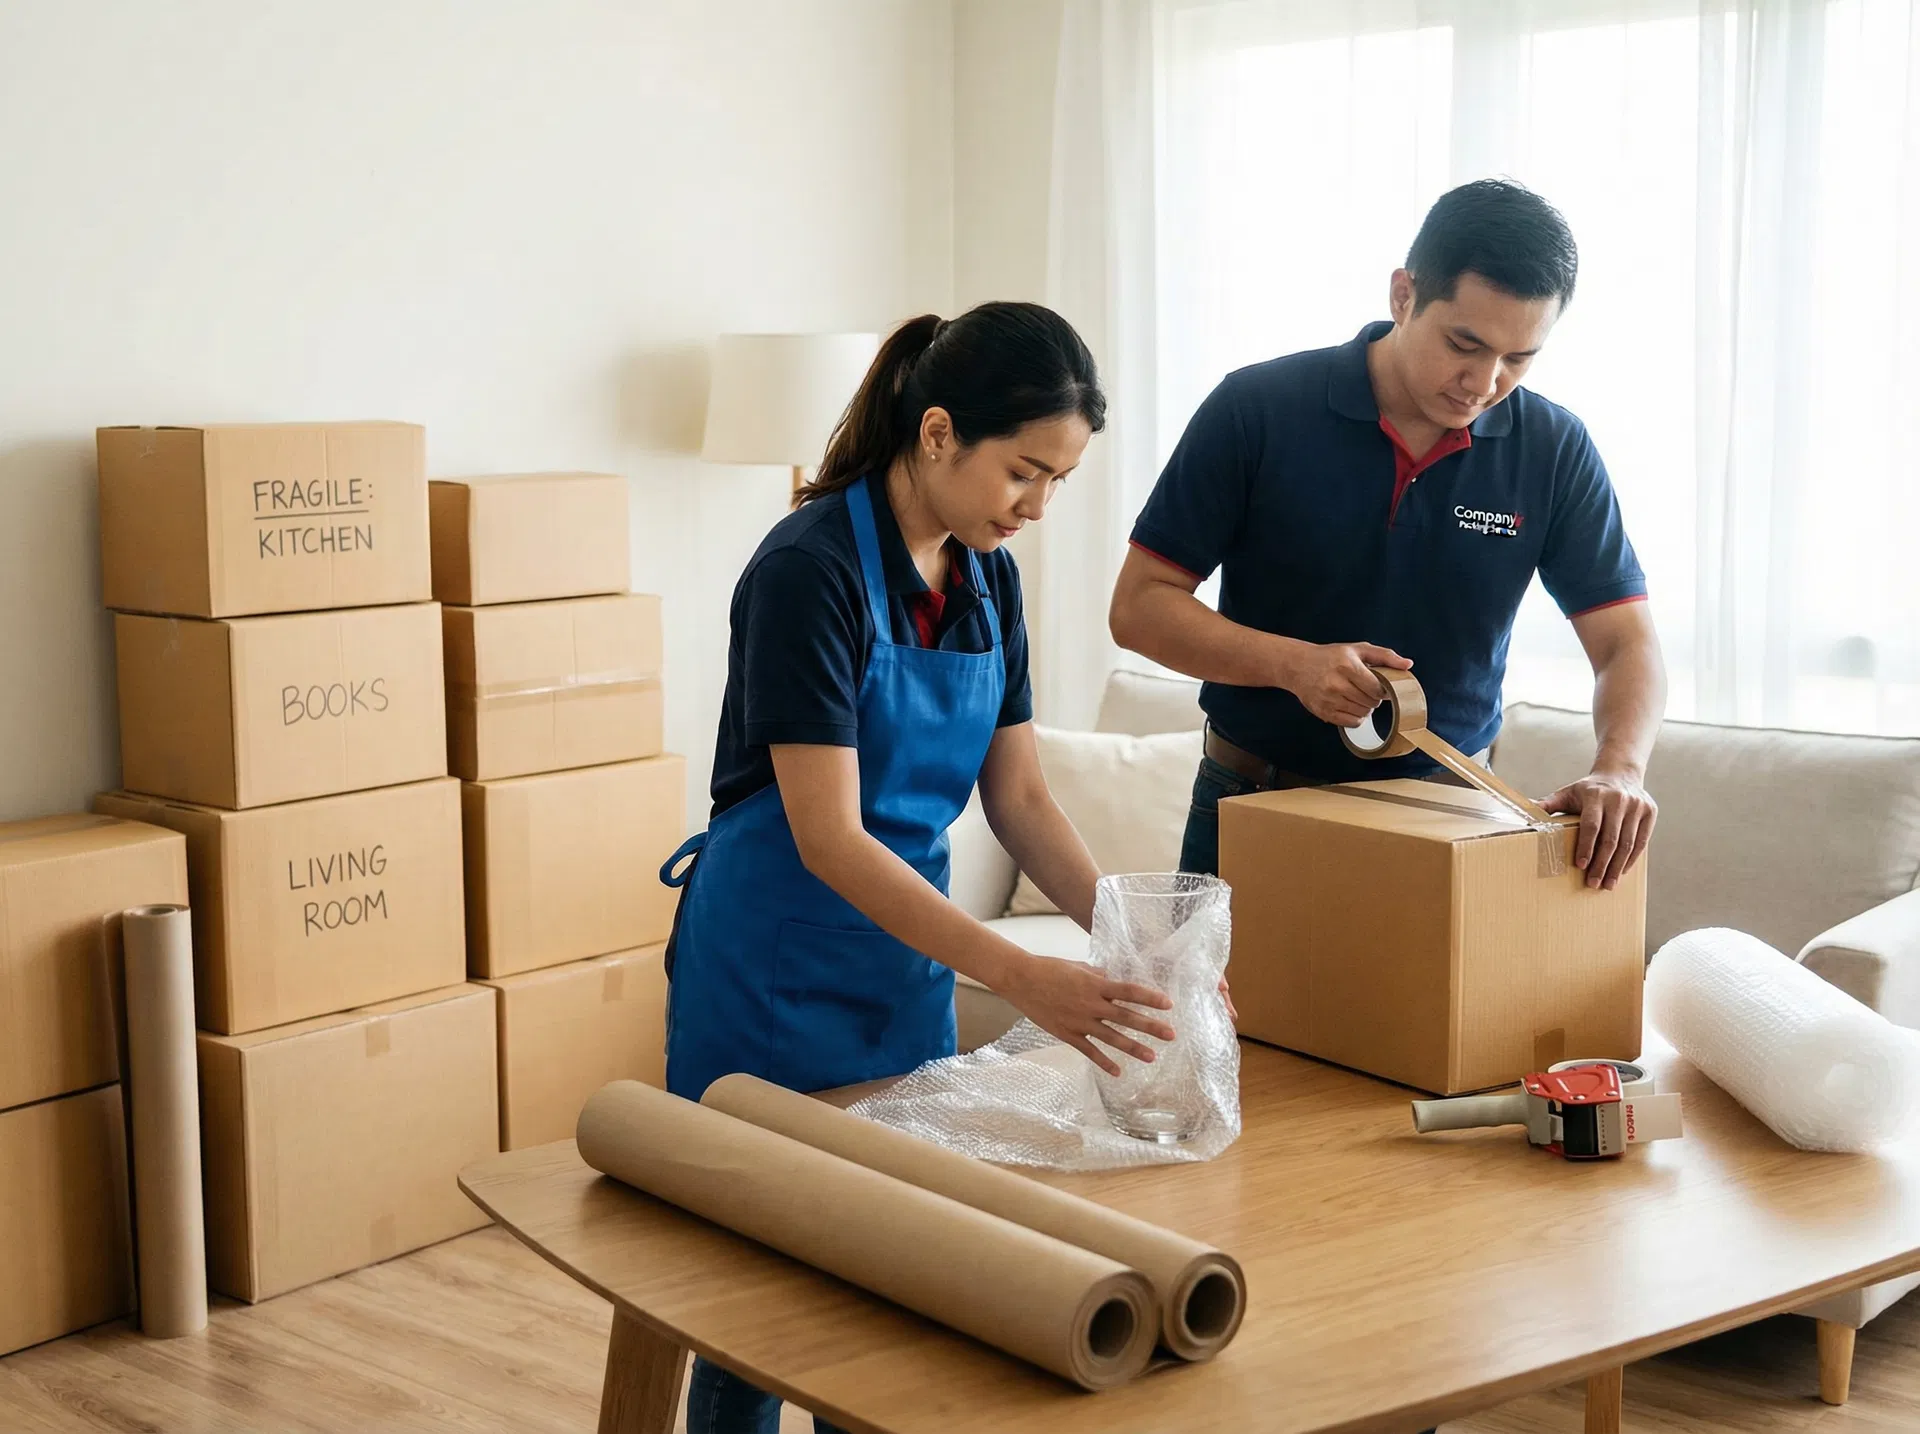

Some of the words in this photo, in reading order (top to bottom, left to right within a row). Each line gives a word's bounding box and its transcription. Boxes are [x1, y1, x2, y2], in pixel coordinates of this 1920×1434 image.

[253, 478, 374, 512] FRAGILE:
[1453, 505, 1516, 529] Company
[258, 524, 373, 559] KITCHEN
[282, 677, 389, 726] BOOKS
[289, 844, 387, 890] LIVING
[304, 889, 388, 937] ROOM
